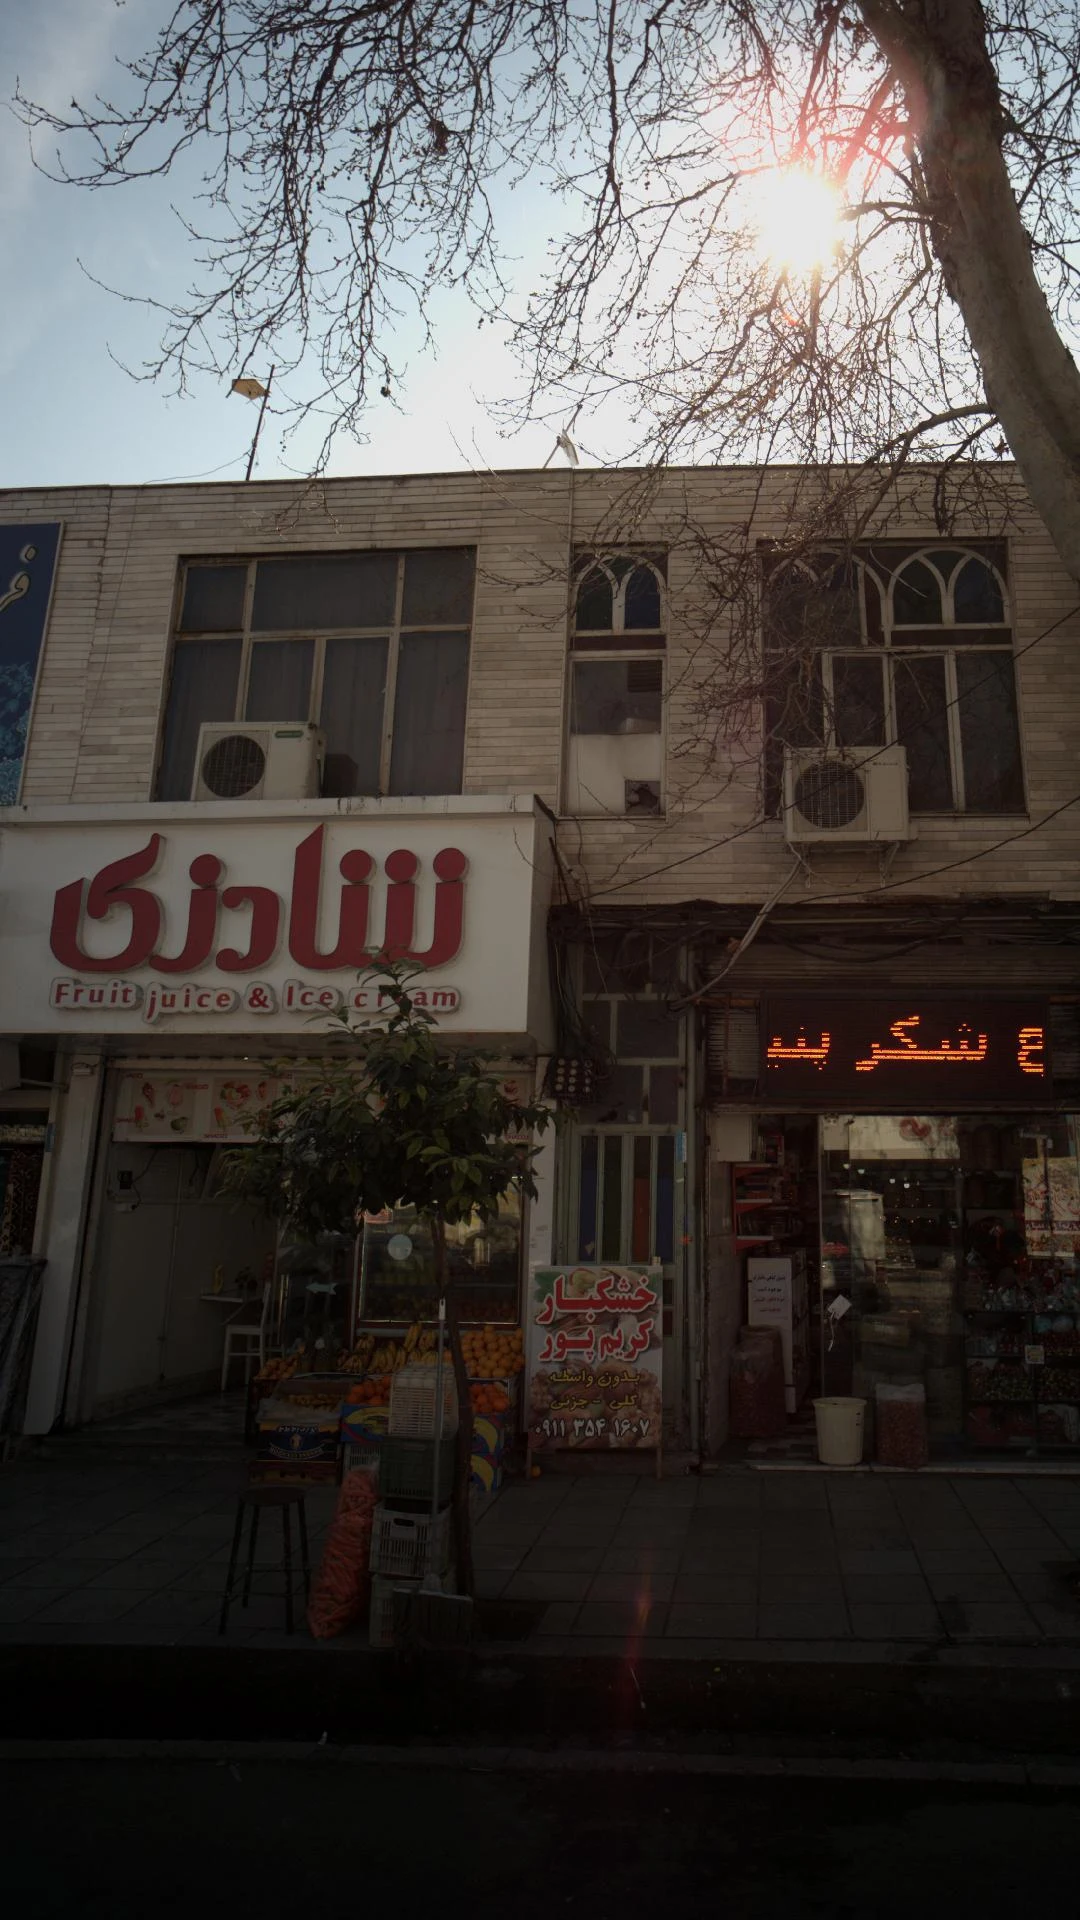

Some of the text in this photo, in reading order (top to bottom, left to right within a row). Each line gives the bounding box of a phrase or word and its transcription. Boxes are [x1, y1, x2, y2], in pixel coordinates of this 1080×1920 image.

[54, 983, 457, 1020] Fruit juice & Ice cram
[855, 1015, 988, 1071] شکر
[536, 1275, 657, 1324] خشکبار
[538, 1318, 654, 1364] کریم پور
[549, 1369, 641, 1387] بدون واسطه
[608, 1394, 639, 1410] کلی
[535, 1418, 650, 1438] ۰۹۱۱ ۳۵۴ ۱۶۰۷
